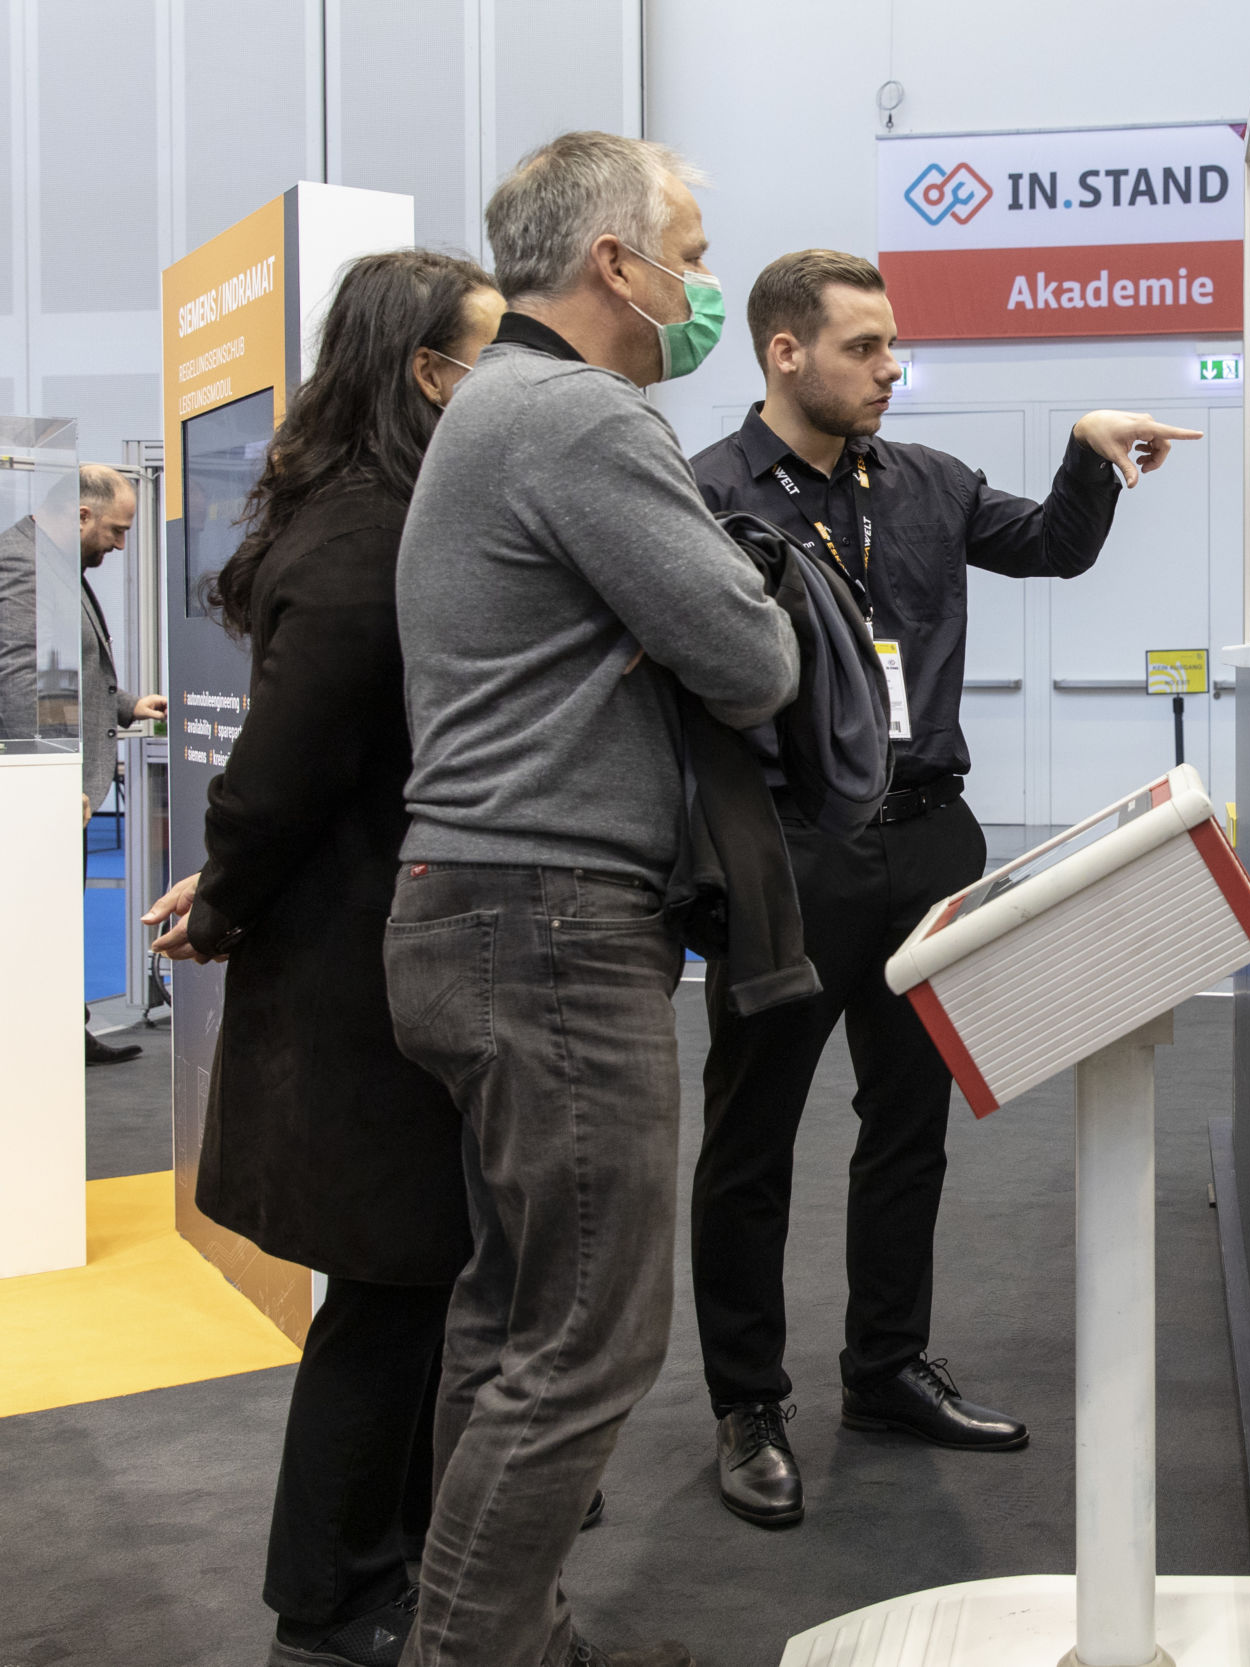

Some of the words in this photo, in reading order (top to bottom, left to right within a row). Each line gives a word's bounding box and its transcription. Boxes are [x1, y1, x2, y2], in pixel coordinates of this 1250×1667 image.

[1008, 164, 1229, 211] IN.STAND
[178, 288, 217, 339] SIEMENS
[222, 254, 276, 317] INDRAMAT
[1007, 267, 1214, 310] Akademie
[178, 336, 245, 383] REGELUNGSEINSCHUB
[178, 376, 233, 416] LEISTUNGSMODUL
[184, 717, 212, 740] #availability
[184, 744, 207, 764] #siemens
